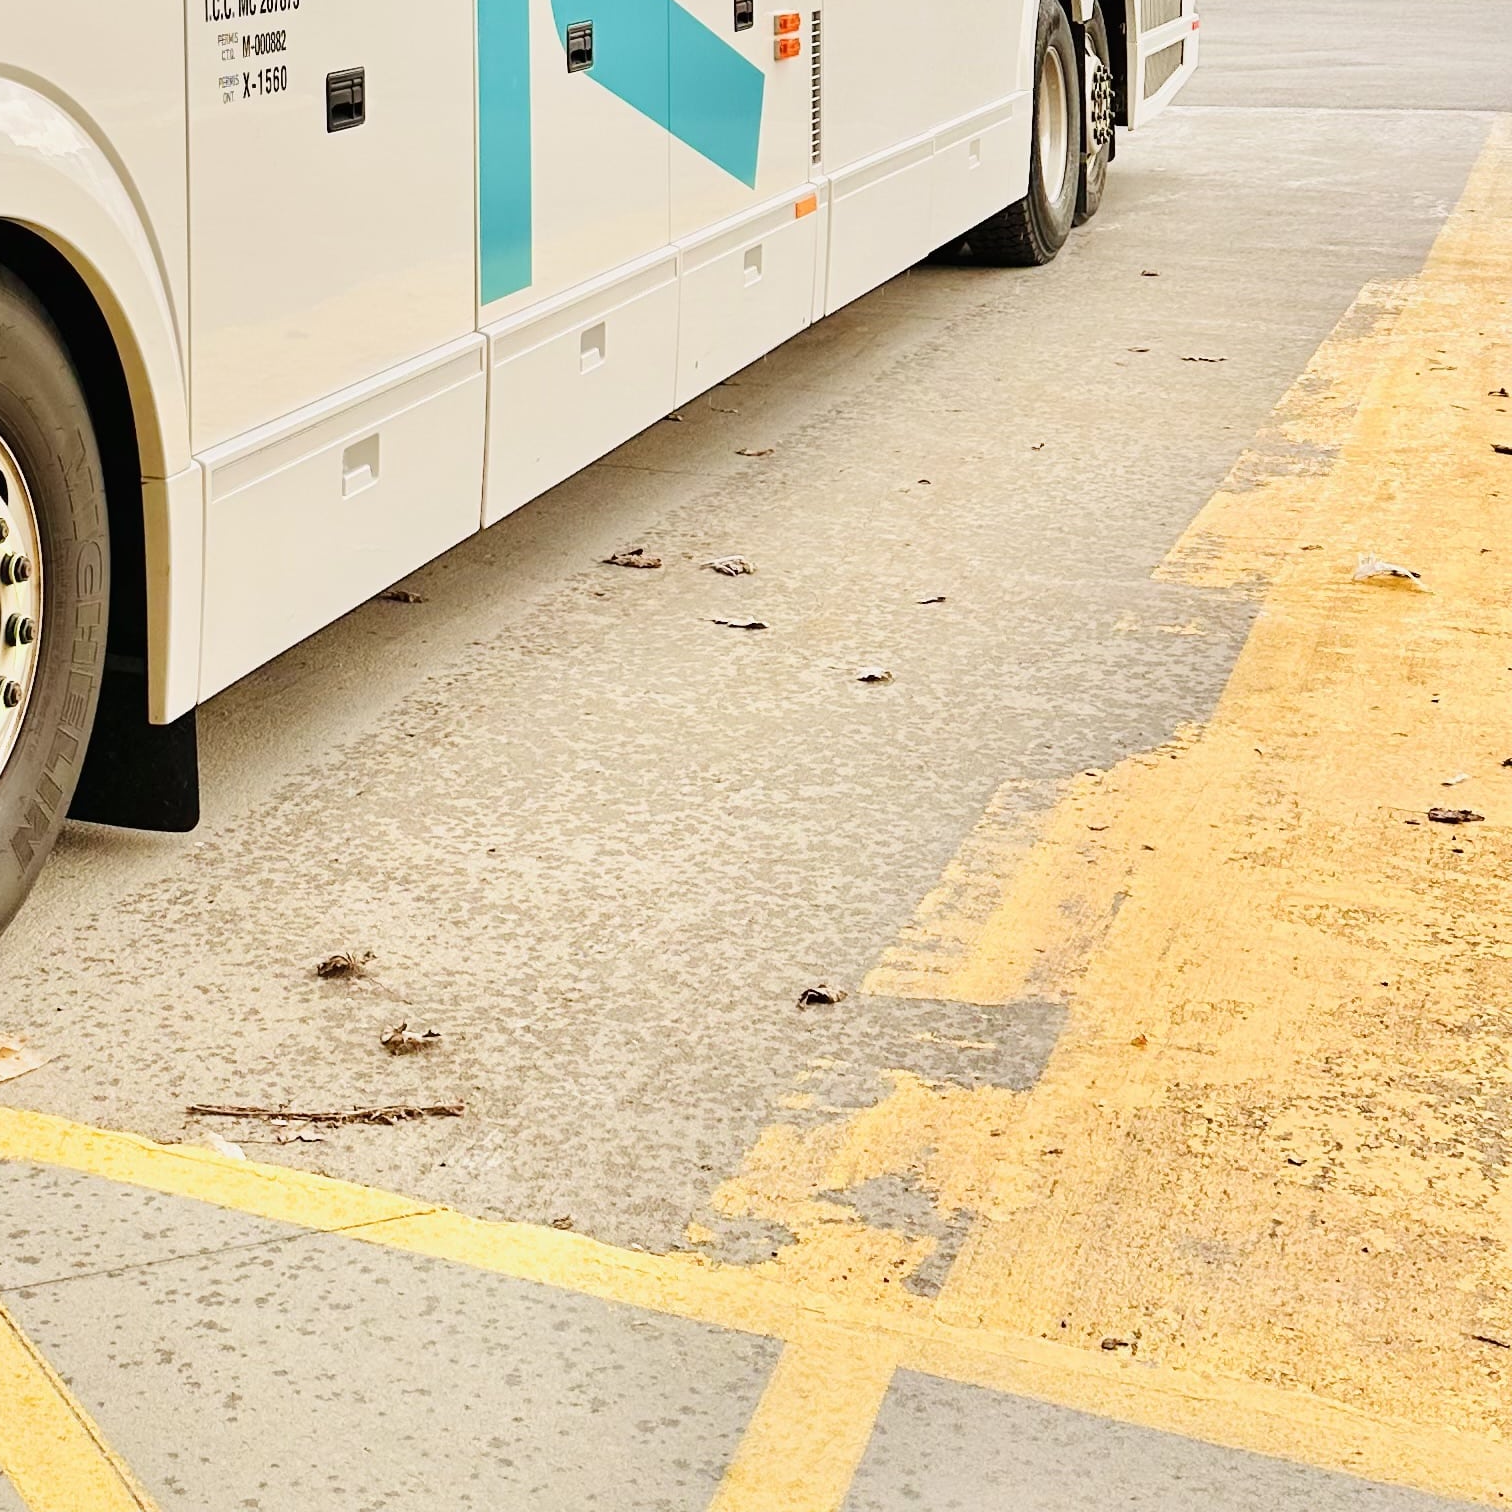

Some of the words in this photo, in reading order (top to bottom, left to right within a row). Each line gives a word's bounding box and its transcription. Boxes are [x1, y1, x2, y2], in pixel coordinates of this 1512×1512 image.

[242, 29, 287, 59] M-000882
[242, 65, 287, 99] X-1560
[9, 426, 103, 874] MICHELIN
